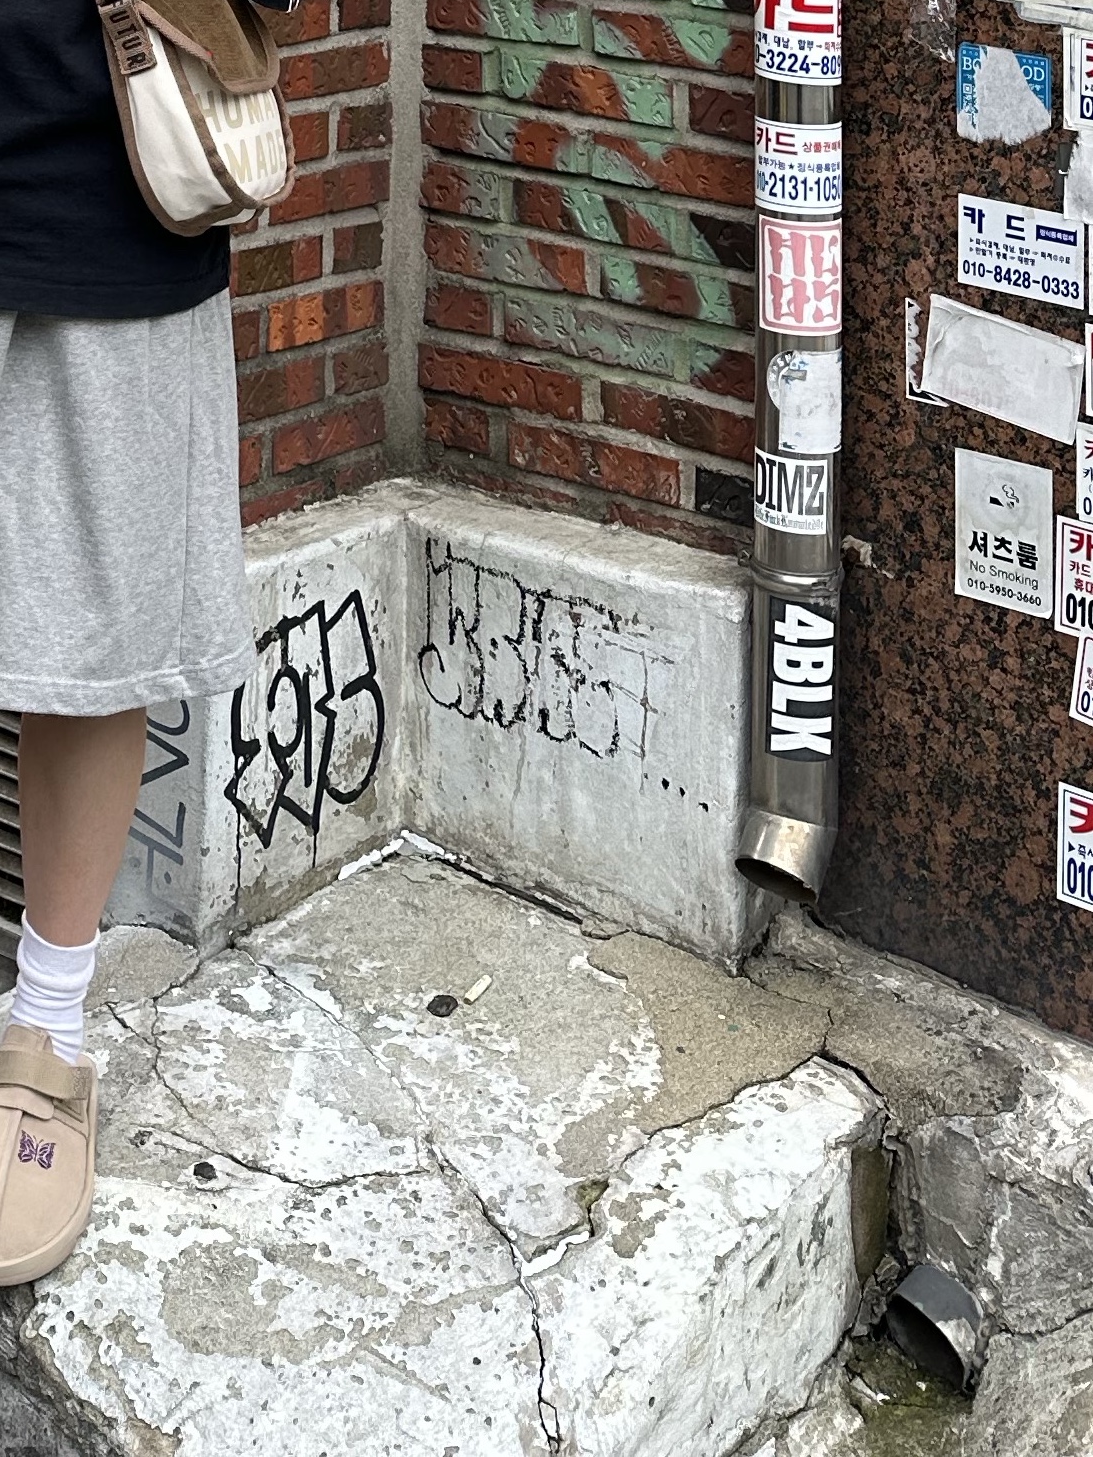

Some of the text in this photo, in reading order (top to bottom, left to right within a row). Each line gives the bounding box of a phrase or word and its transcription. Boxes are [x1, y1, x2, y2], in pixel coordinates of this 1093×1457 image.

[224, 129, 285, 185] MADE
[756, 127, 798, 156] 카드
[963, 205, 1025, 241] 카드
[962, 259, 1080, 300] 010-8428-0333
[755, 452, 825, 516] DIMZ
[968, 529, 1039, 571] 셔츠룸
[967, 577, 1042, 607] 010-5950-3660
[969, 559, 1039, 591] No Smoking
[769, 603, 835, 756] 4BLK
